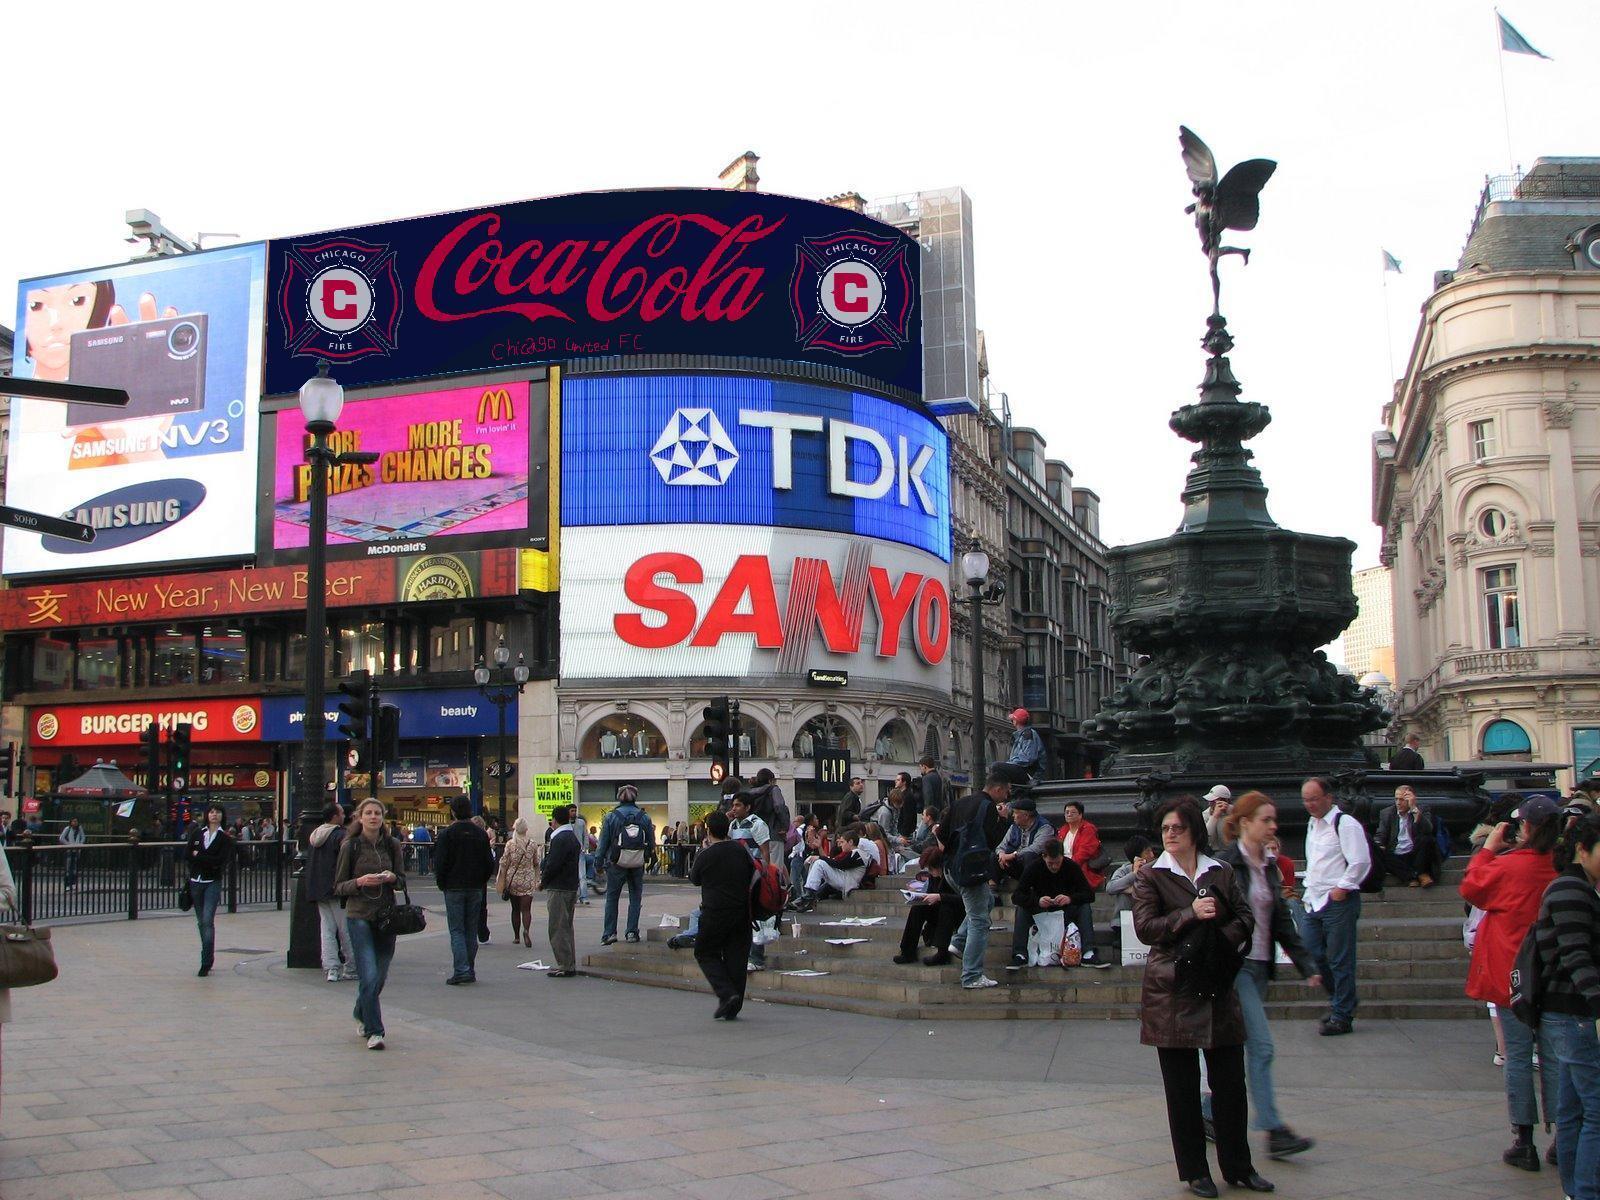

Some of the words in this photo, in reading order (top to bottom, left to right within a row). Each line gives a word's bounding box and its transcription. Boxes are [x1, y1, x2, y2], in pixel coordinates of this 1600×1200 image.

[314, 249, 366, 263] CHICAGO
[825, 242, 877, 256] CHICAGO
[415, 213, 788, 323] Coca-Cola
[87, 336, 124, 347] SAMSUNG
[328, 341, 353, 351] FIRE
[619, 333, 644, 350] FC
[839, 335, 864, 344] FIRE
[407, 418, 464, 451] MORE
[72, 434, 147, 460] SAMSUNG
[380, 443, 494, 484] CHANCES
[739, 408, 939, 518] TDK
[13, 513, 38, 526] SOHO
[367, 541, 428, 556] McDonald's
[418, 576, 456, 591] HARBIN
[96, 588, 148, 614] New
[154, 582, 219, 612] Year,
[229, 576, 285, 604] New
[27, 590, 68, 624] 亥
[613, 549, 951, 668] SANYO
[441, 705, 478, 718] beauty
[81, 713, 154, 735] BURGER
[821, 758, 846, 783] GAP
[538, 791, 572, 801] WAXING
